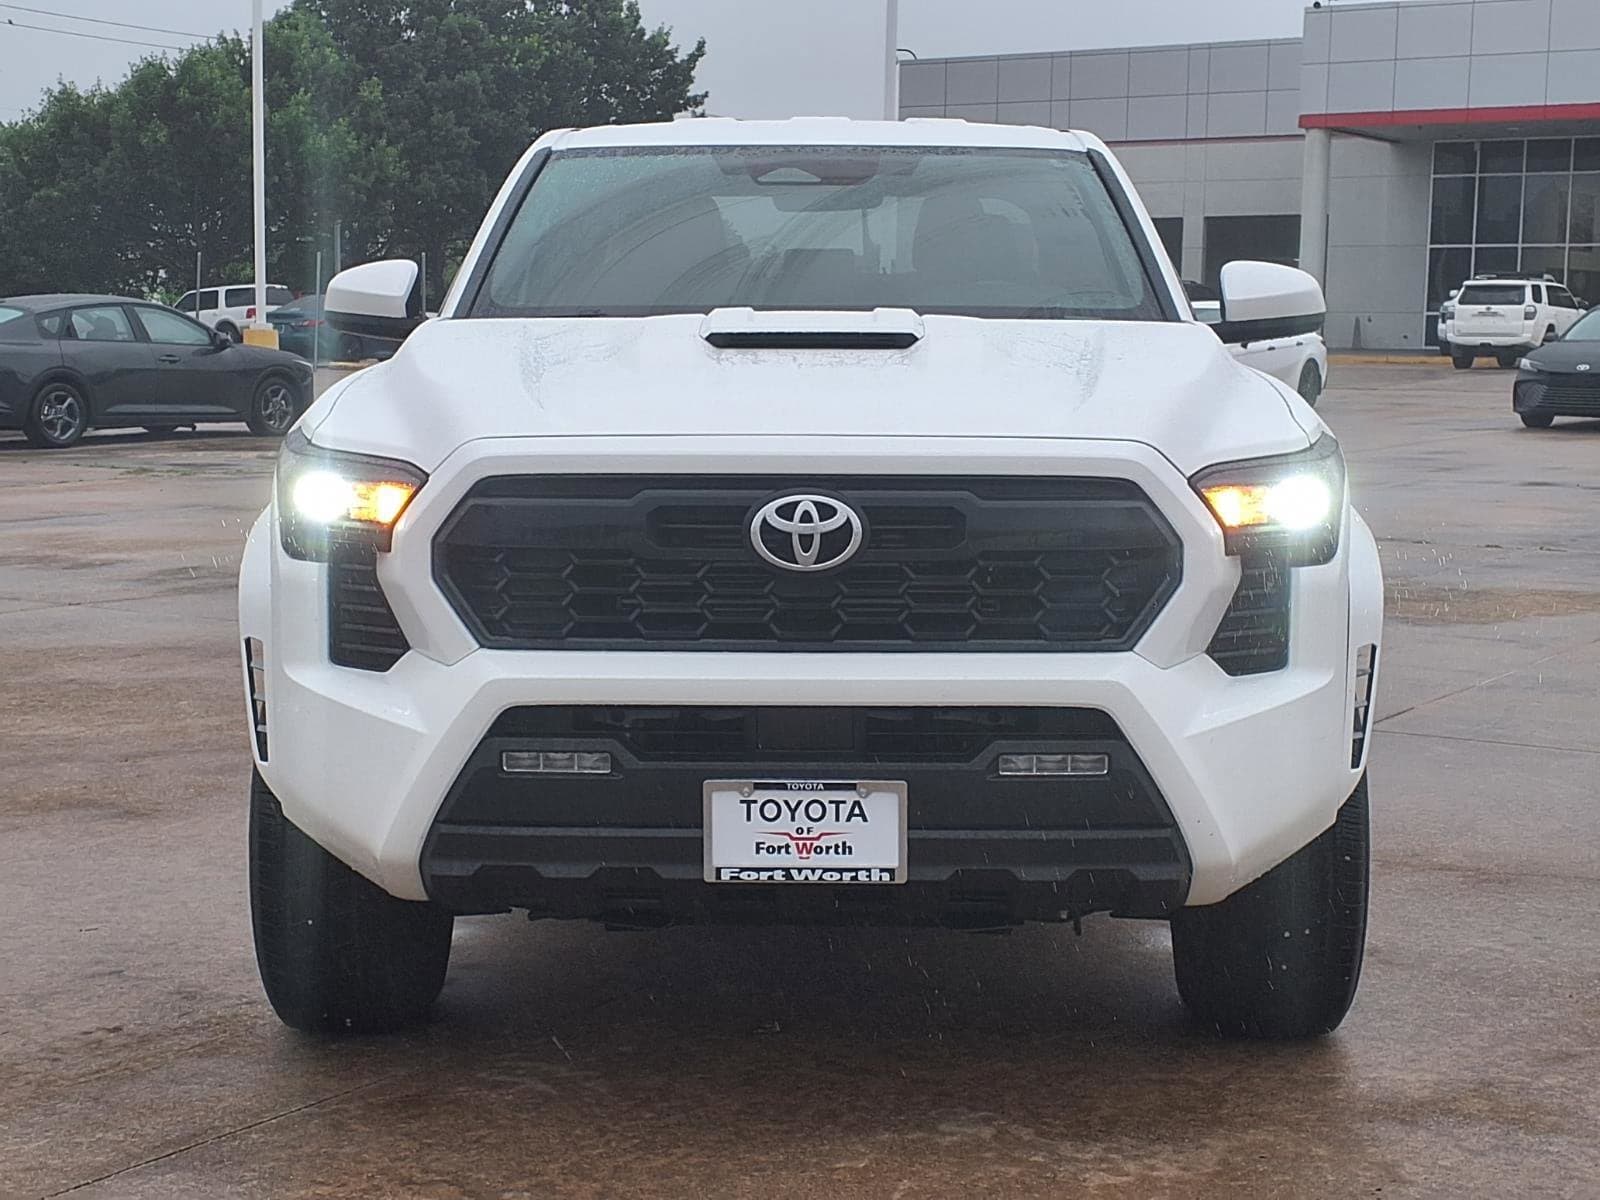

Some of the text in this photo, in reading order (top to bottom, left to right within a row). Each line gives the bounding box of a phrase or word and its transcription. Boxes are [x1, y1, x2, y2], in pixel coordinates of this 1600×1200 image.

[786, 783, 825, 791] TOYOTA
[739, 799, 869, 823] TOYOTA
[795, 827, 815, 835] OF
[755, 841, 853, 856] Fort Worth
[720, 868, 891, 881] Fort Worth
